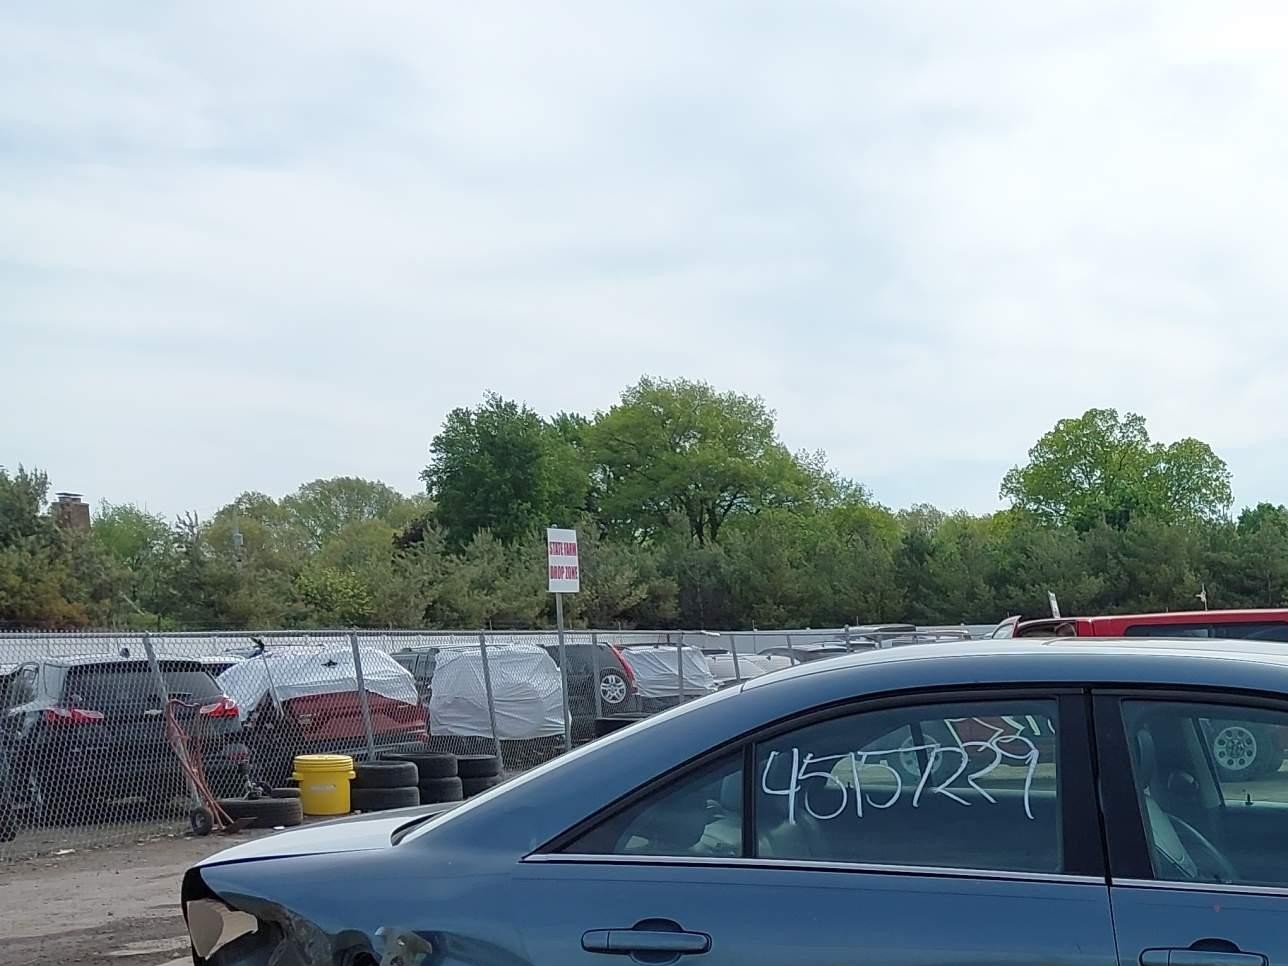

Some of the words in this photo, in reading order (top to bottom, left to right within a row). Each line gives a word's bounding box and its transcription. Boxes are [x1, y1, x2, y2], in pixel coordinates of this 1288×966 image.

[549, 541, 563, 556] STATE
[550, 565, 564, 580] DROP
[565, 565, 578, 580] ZONE
[761, 735, 1040, 826] 45157229
